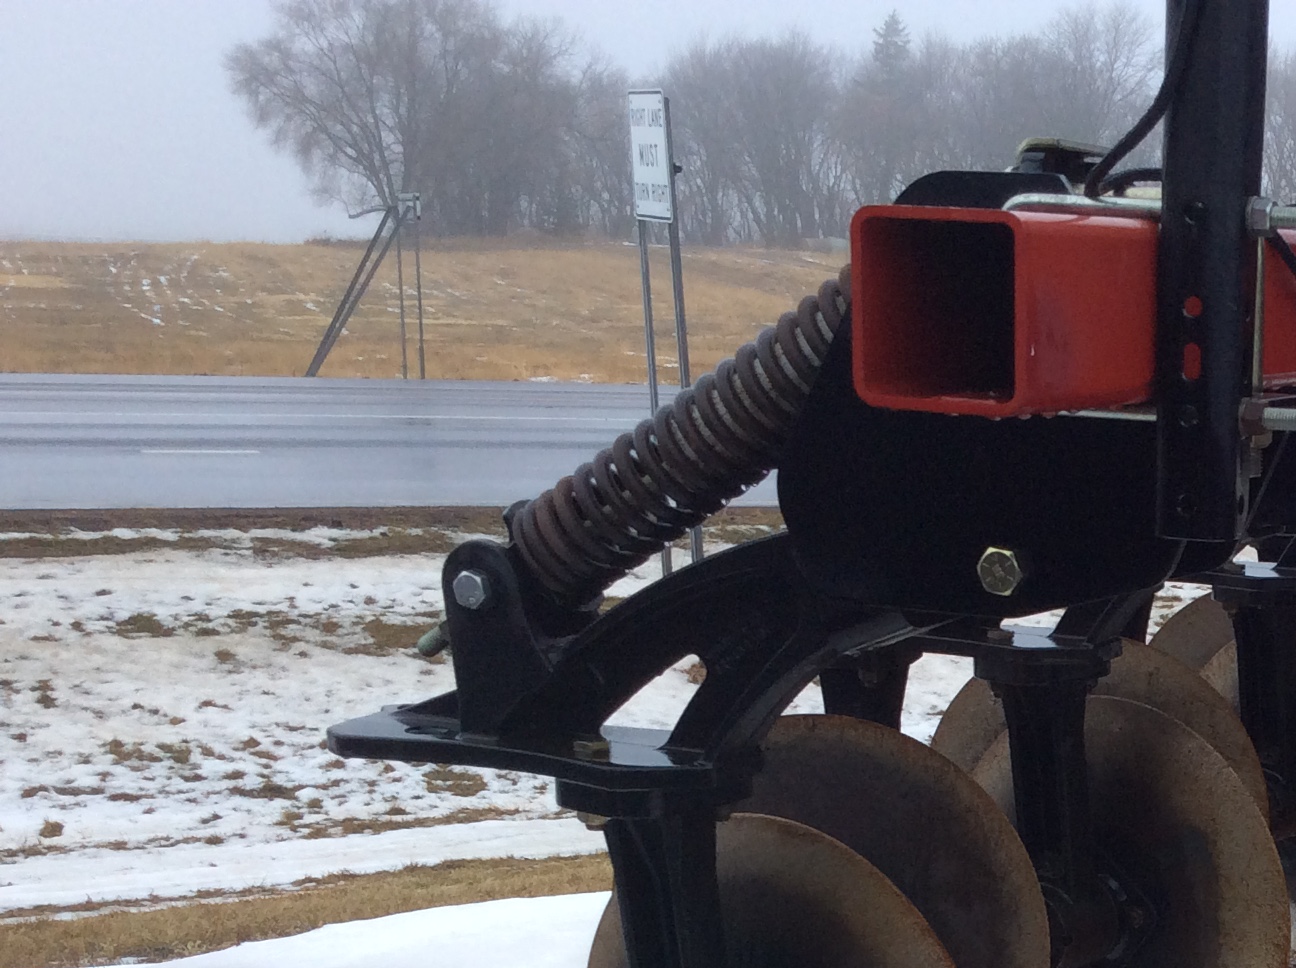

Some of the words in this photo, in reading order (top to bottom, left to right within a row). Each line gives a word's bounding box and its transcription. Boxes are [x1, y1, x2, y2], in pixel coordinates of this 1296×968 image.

[631, 108, 646, 127] RIGHT
[647, 108, 662, 128] LANE
[638, 143, 659, 167] MUST
[635, 182, 650, 201] TURN
[651, 183, 669, 203] RIGHT
